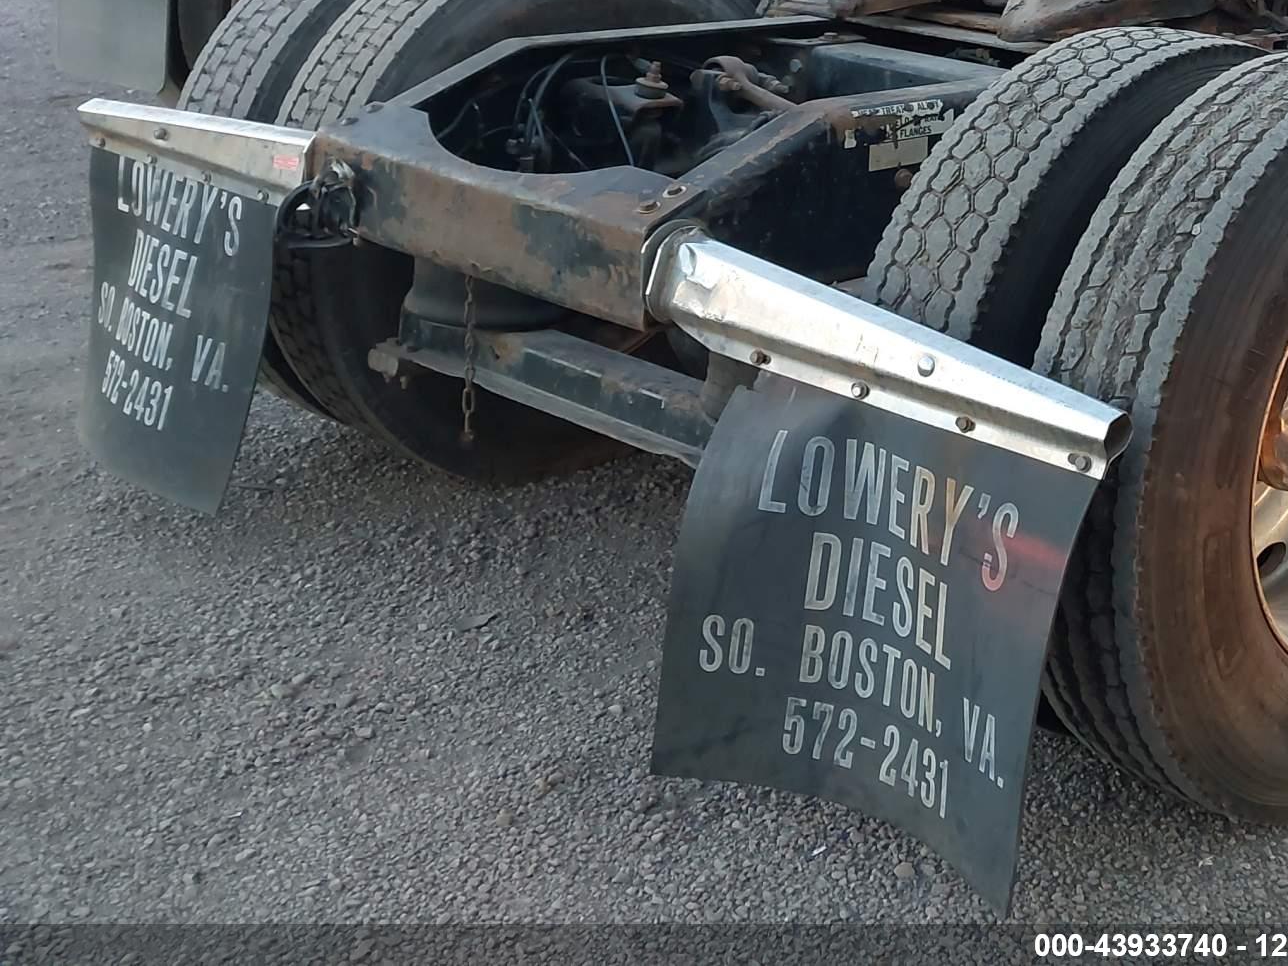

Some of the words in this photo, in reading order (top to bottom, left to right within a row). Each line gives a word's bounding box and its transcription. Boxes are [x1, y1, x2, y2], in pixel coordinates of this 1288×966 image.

[116, 153, 243, 257] LOWERY'S
[127, 228, 200, 319] DIESEL
[98, 281, 115, 333] SO.
[114, 296, 174, 372] BOSTON,
[191, 334, 230, 393] VA.
[101, 349, 174, 431] 572-2431
[757, 428, 1020, 593] LOWERY'S
[803, 531, 952, 671] DIESEL
[699, 614, 766, 678] SO.
[798, 624, 942, 738] BOSTON,
[962, 697, 1005, 789] VA.
[781, 696, 950, 820] 572-2431
